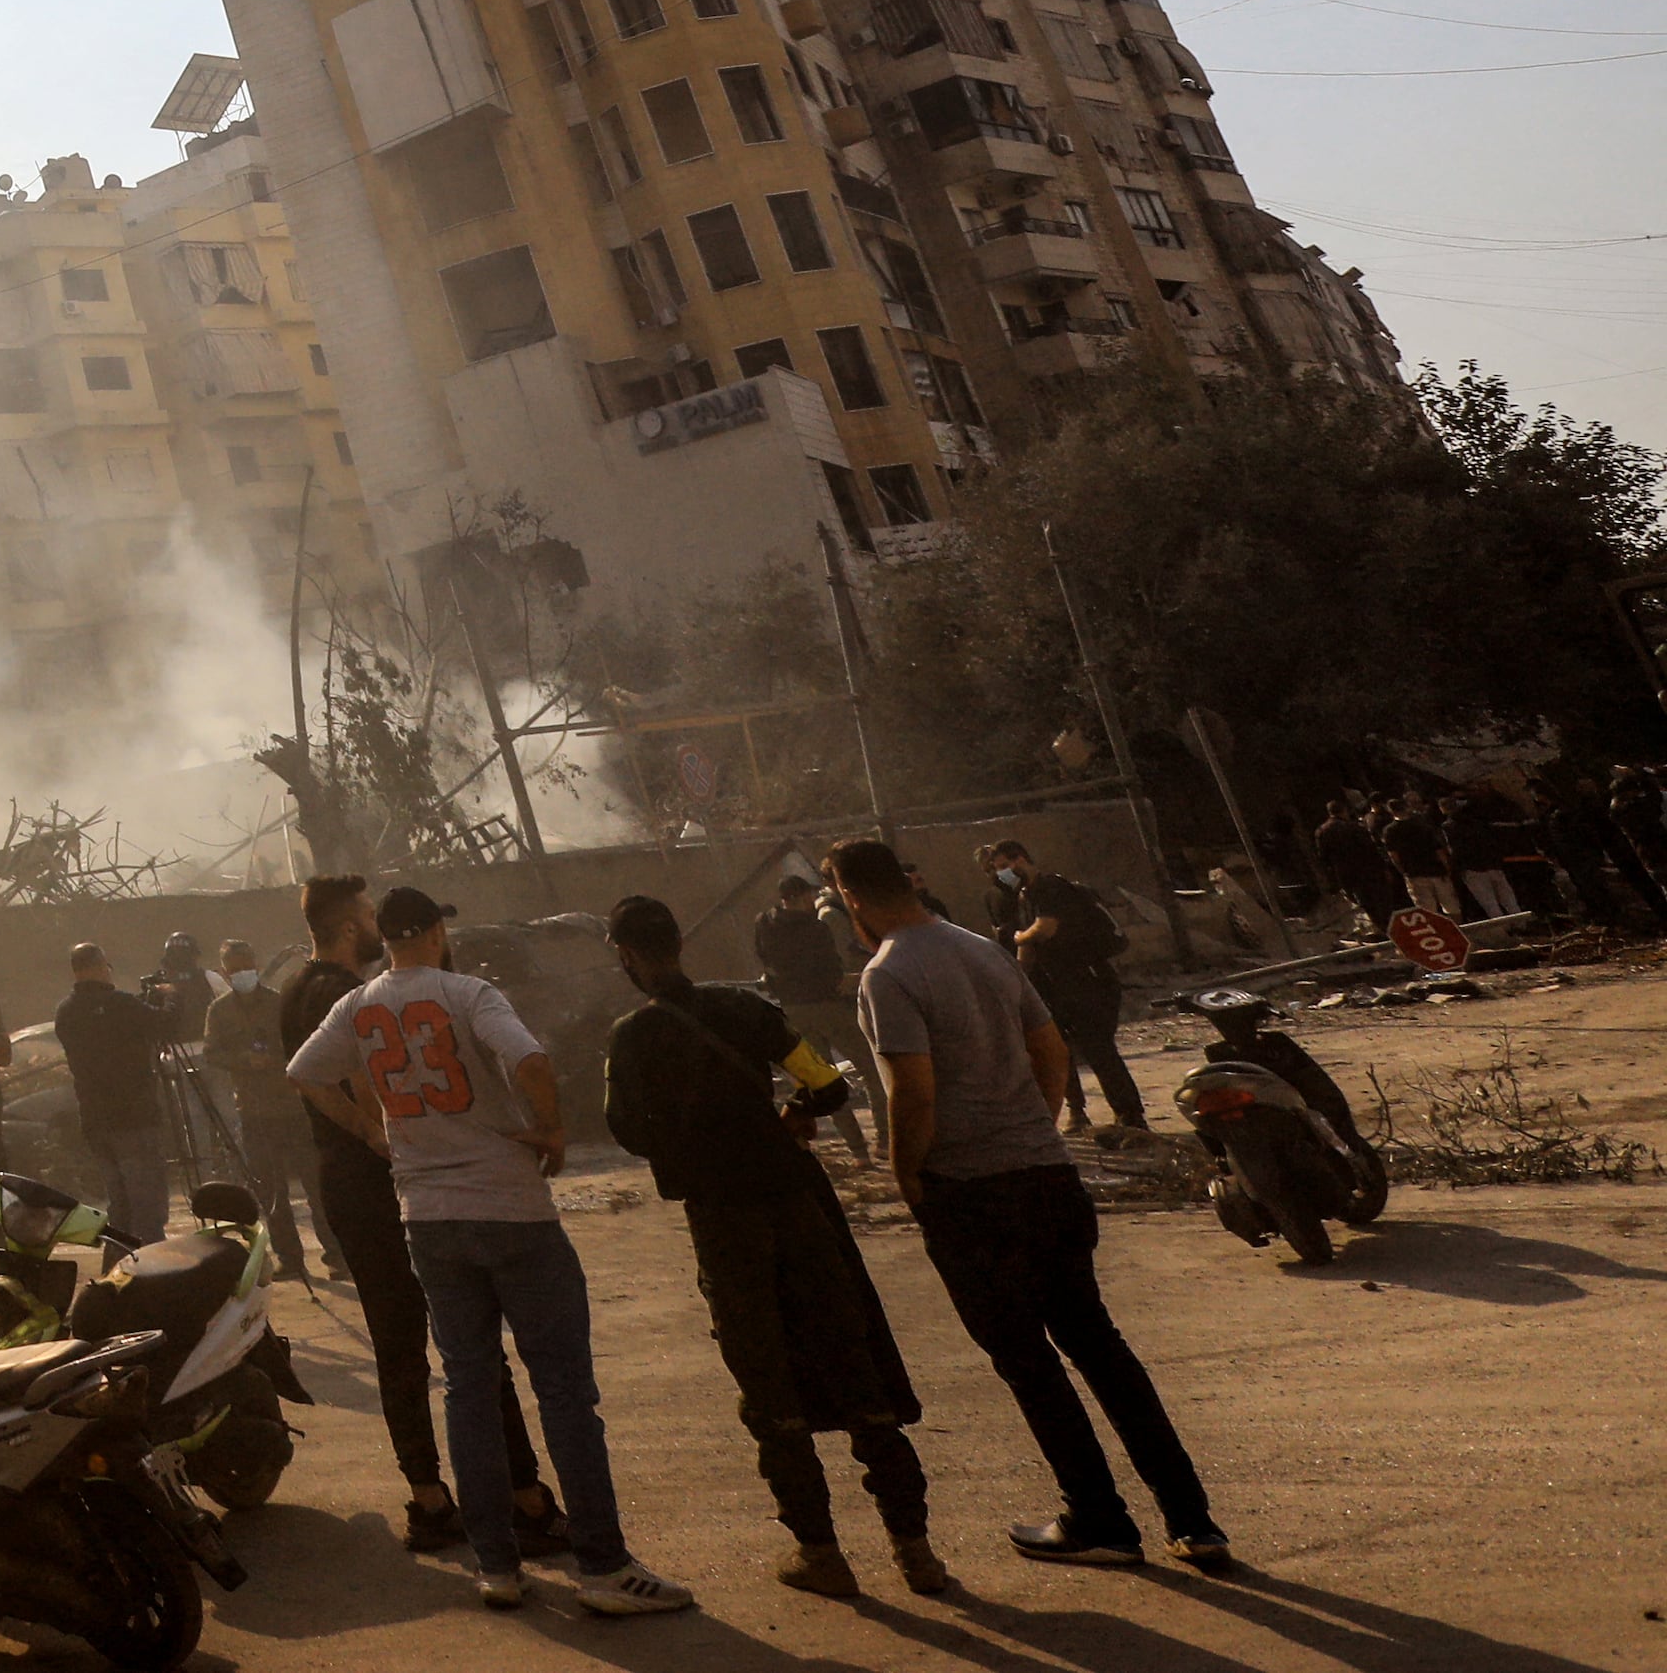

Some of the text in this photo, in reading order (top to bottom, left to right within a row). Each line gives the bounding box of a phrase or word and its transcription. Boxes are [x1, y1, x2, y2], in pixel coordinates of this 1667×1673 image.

[677, 384, 761, 427] PALM
[1401, 912, 1456, 964] STOP
[354, 1000, 474, 1118] 23
